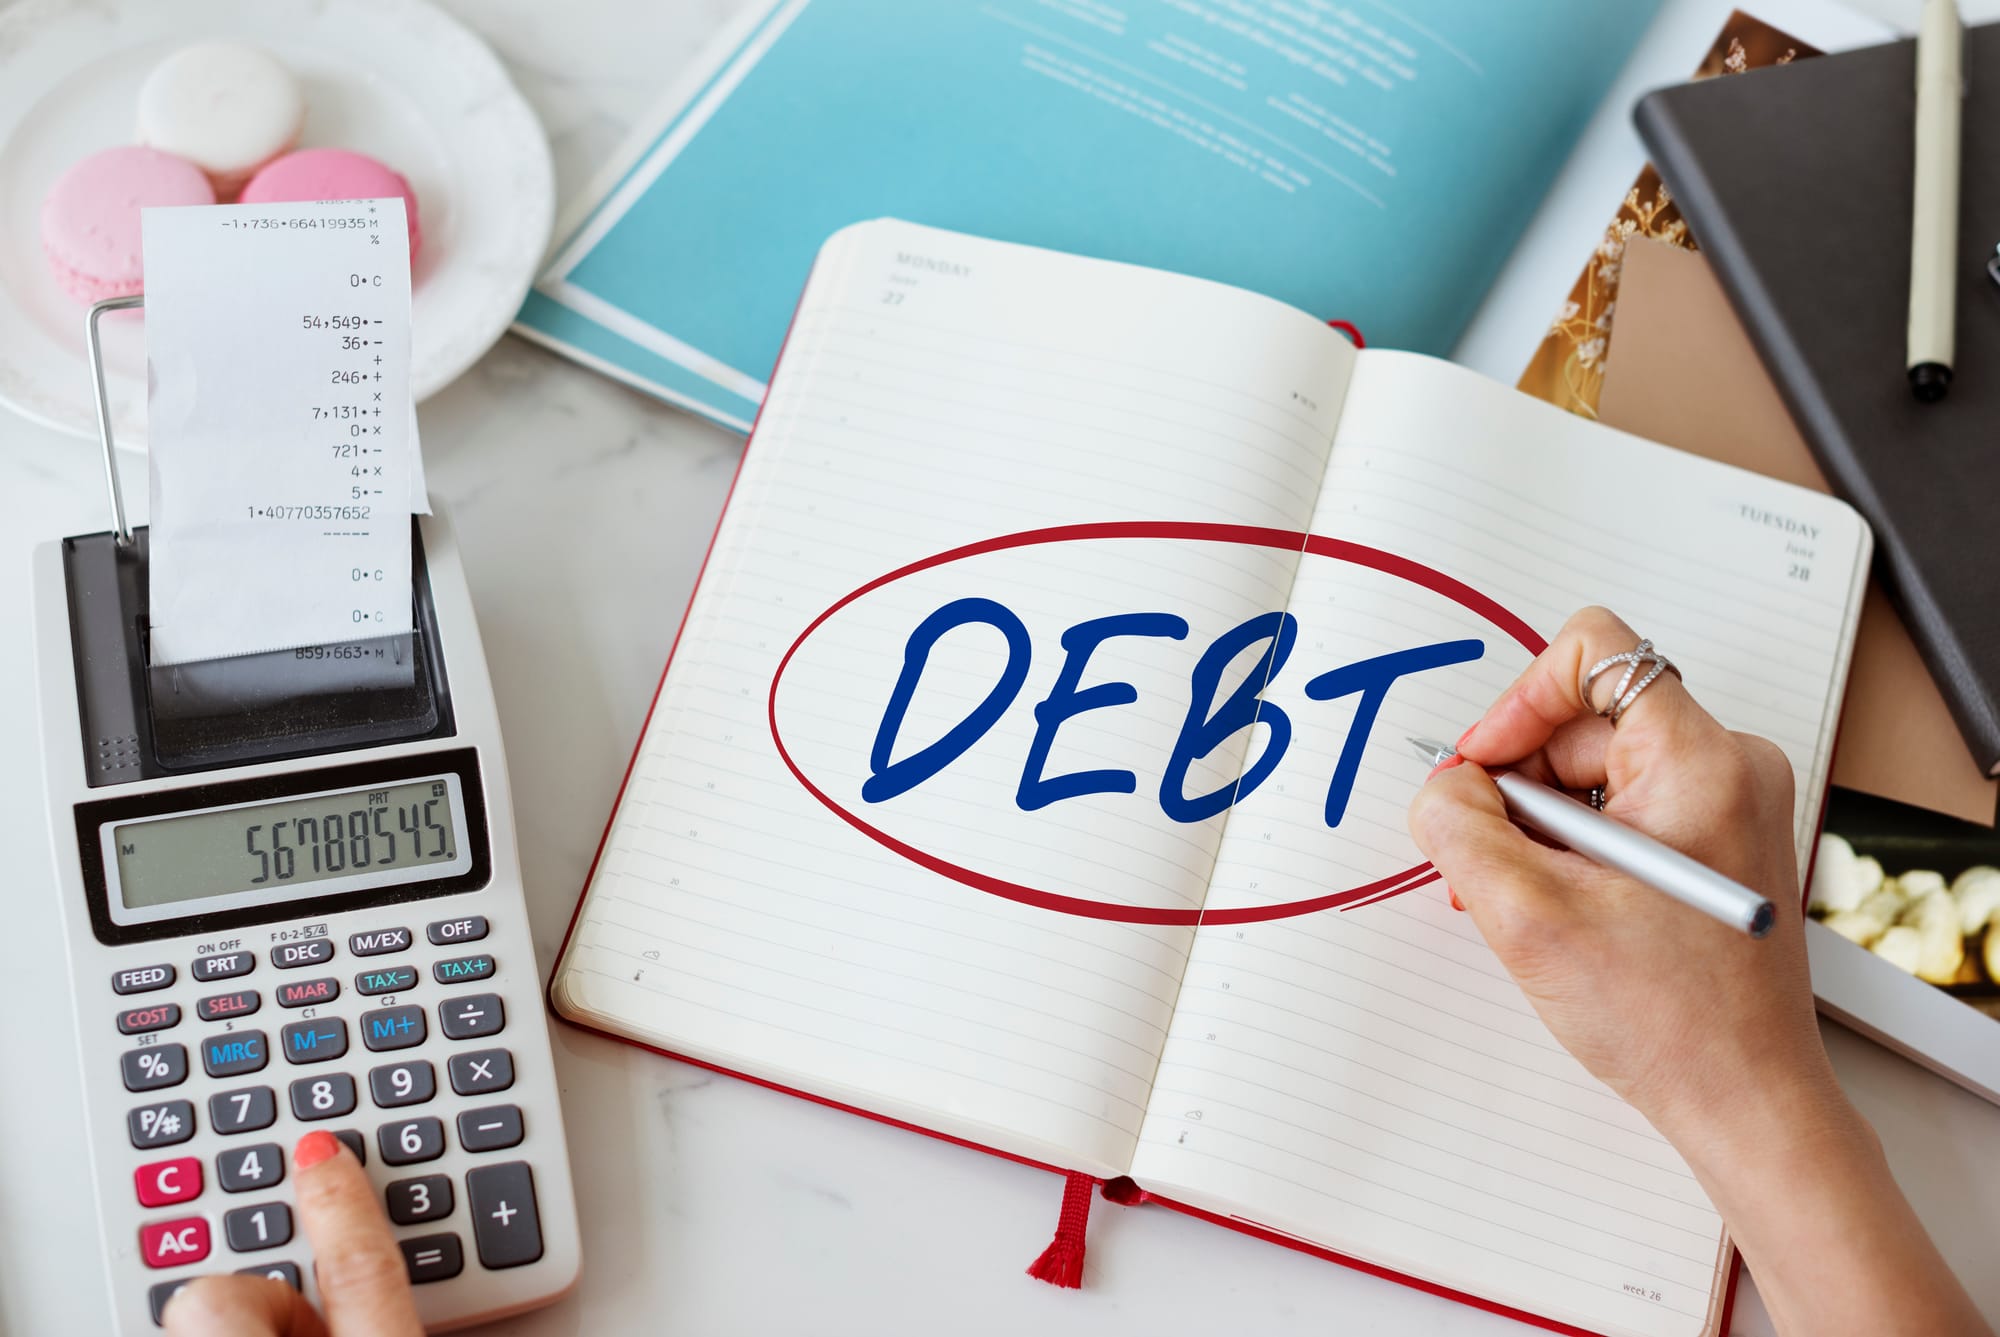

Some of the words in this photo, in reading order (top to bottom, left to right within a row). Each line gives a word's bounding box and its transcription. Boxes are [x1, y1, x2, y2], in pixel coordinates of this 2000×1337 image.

[896, 250, 972, 277] MONDAY
[373, 275, 382, 287] C
[881, 289, 906, 306] 27
[1740, 504, 1820, 540] TUESDAY
[374, 569, 383, 581] C
[1787, 562, 1811, 582] 28
[862, 598, 1484, 827] DEBT
[368, 791, 390, 806] PRT
[122, 843, 135, 856] M
[441, 920, 474, 938] OFF
[197, 943, 216, 955] ON
[219, 938, 241, 951] OFF
[356, 930, 405, 951] M/EX
[284, 943, 321, 962] DEC
[206, 955, 239, 974] PRT
[442, 959, 488, 978] TAX+
[121, 967, 166, 987] FEED
[286, 981, 329, 1001] MAR
[381, 995, 397, 1006] C2
[208, 995, 248, 1014] SELL
[302, 1007, 317, 1019] C1
[126, 1006, 169, 1028] COST
[373, 1015, 416, 1039] M+
[138, 1033, 158, 1046] SET
[211, 1039, 259, 1065] MRC
[138, 1053, 169, 1079] %
[391, 1067, 413, 1098] 9
[312, 1080, 335, 1110] 8
[230, 1093, 252, 1124] 7
[141, 1106, 181, 1138] P/#
[400, 1124, 423, 1154] 6
[238, 1151, 263, 1181] 4
[156, 1167, 180, 1195] C
[410, 1184, 431, 1215] 3
[250, 1211, 267, 1241] 1
[157, 1227, 199, 1257] AC
[1623, 1282, 1646, 1297] week
[1649, 1290, 1662, 1302] 26
